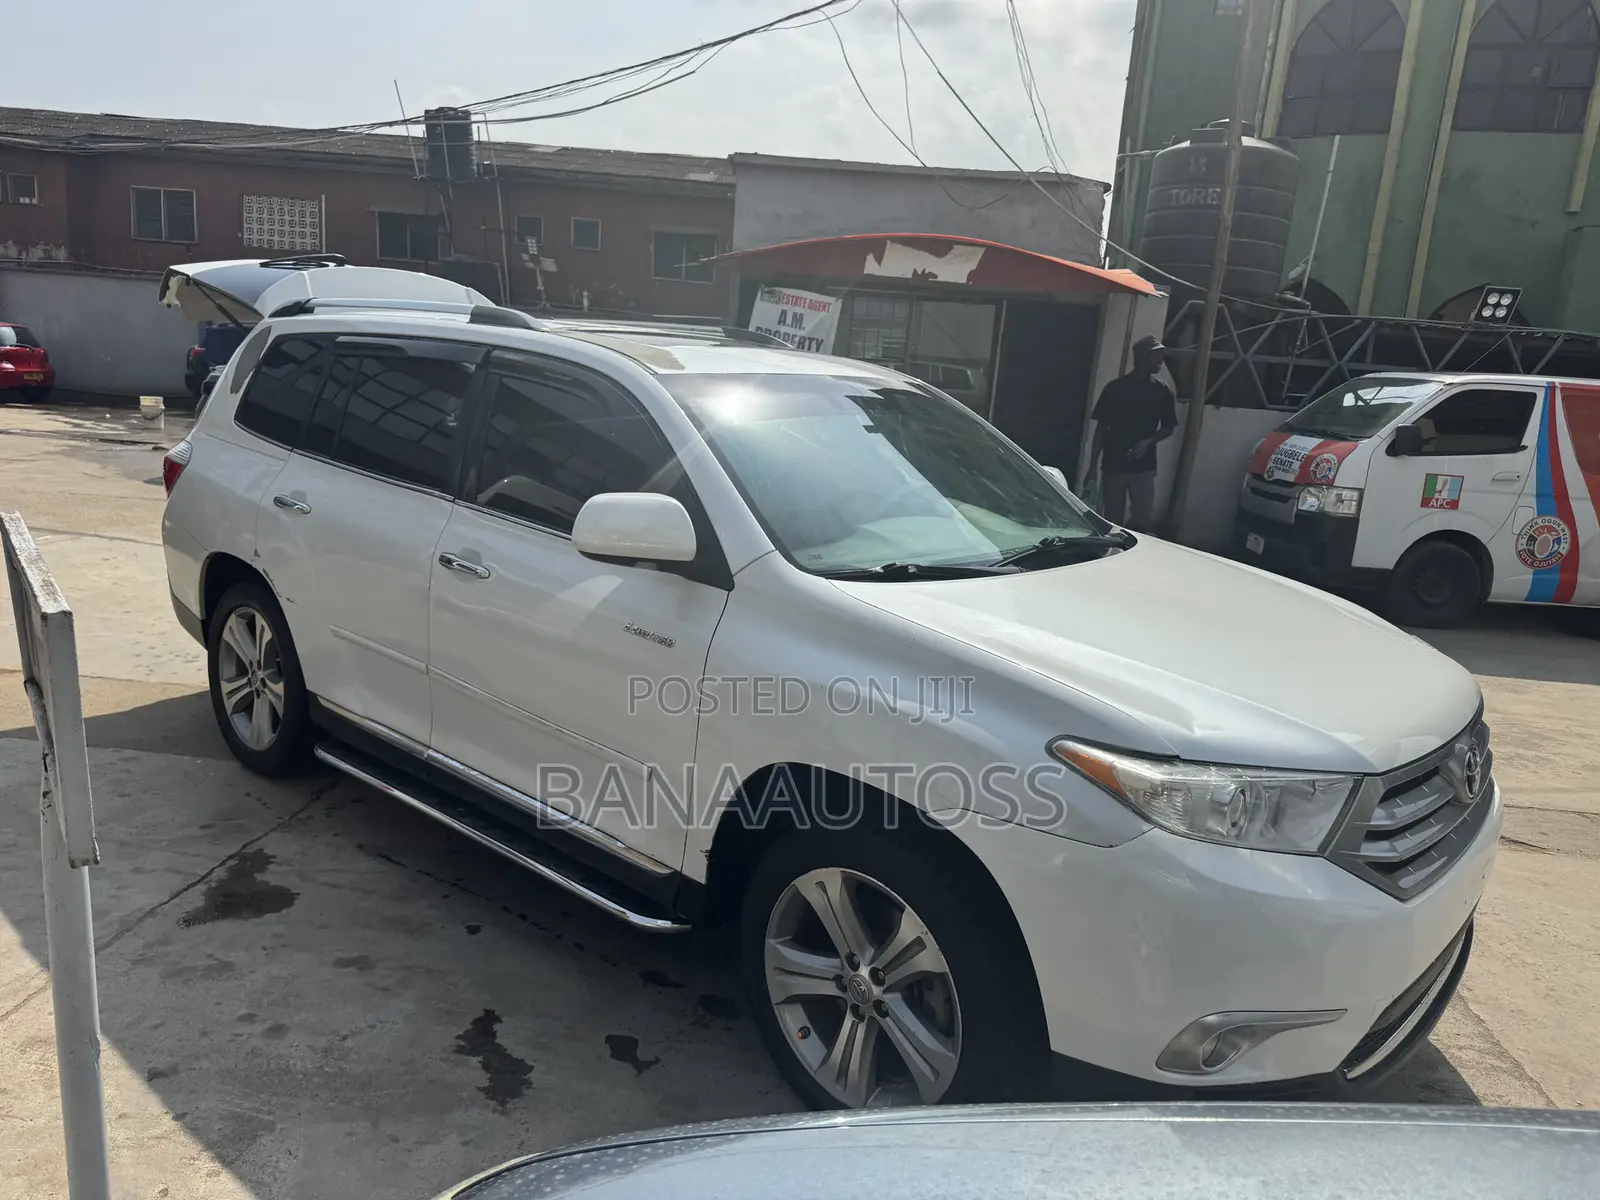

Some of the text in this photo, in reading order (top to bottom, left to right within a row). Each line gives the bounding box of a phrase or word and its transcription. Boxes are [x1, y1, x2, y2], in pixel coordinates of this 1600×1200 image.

[781, 293, 832, 313] ESTATE AGENT
[777, 309, 805, 331] A.M.
[1272, 456, 1294, 469] SENATE
[1429, 498, 1451, 508] APC
[1520, 520, 1539, 540] THINK
[1540, 518, 1562, 529] OGUN
[1560, 526, 1568, 545] WEST
[1520, 549, 1533, 565] VOTE
